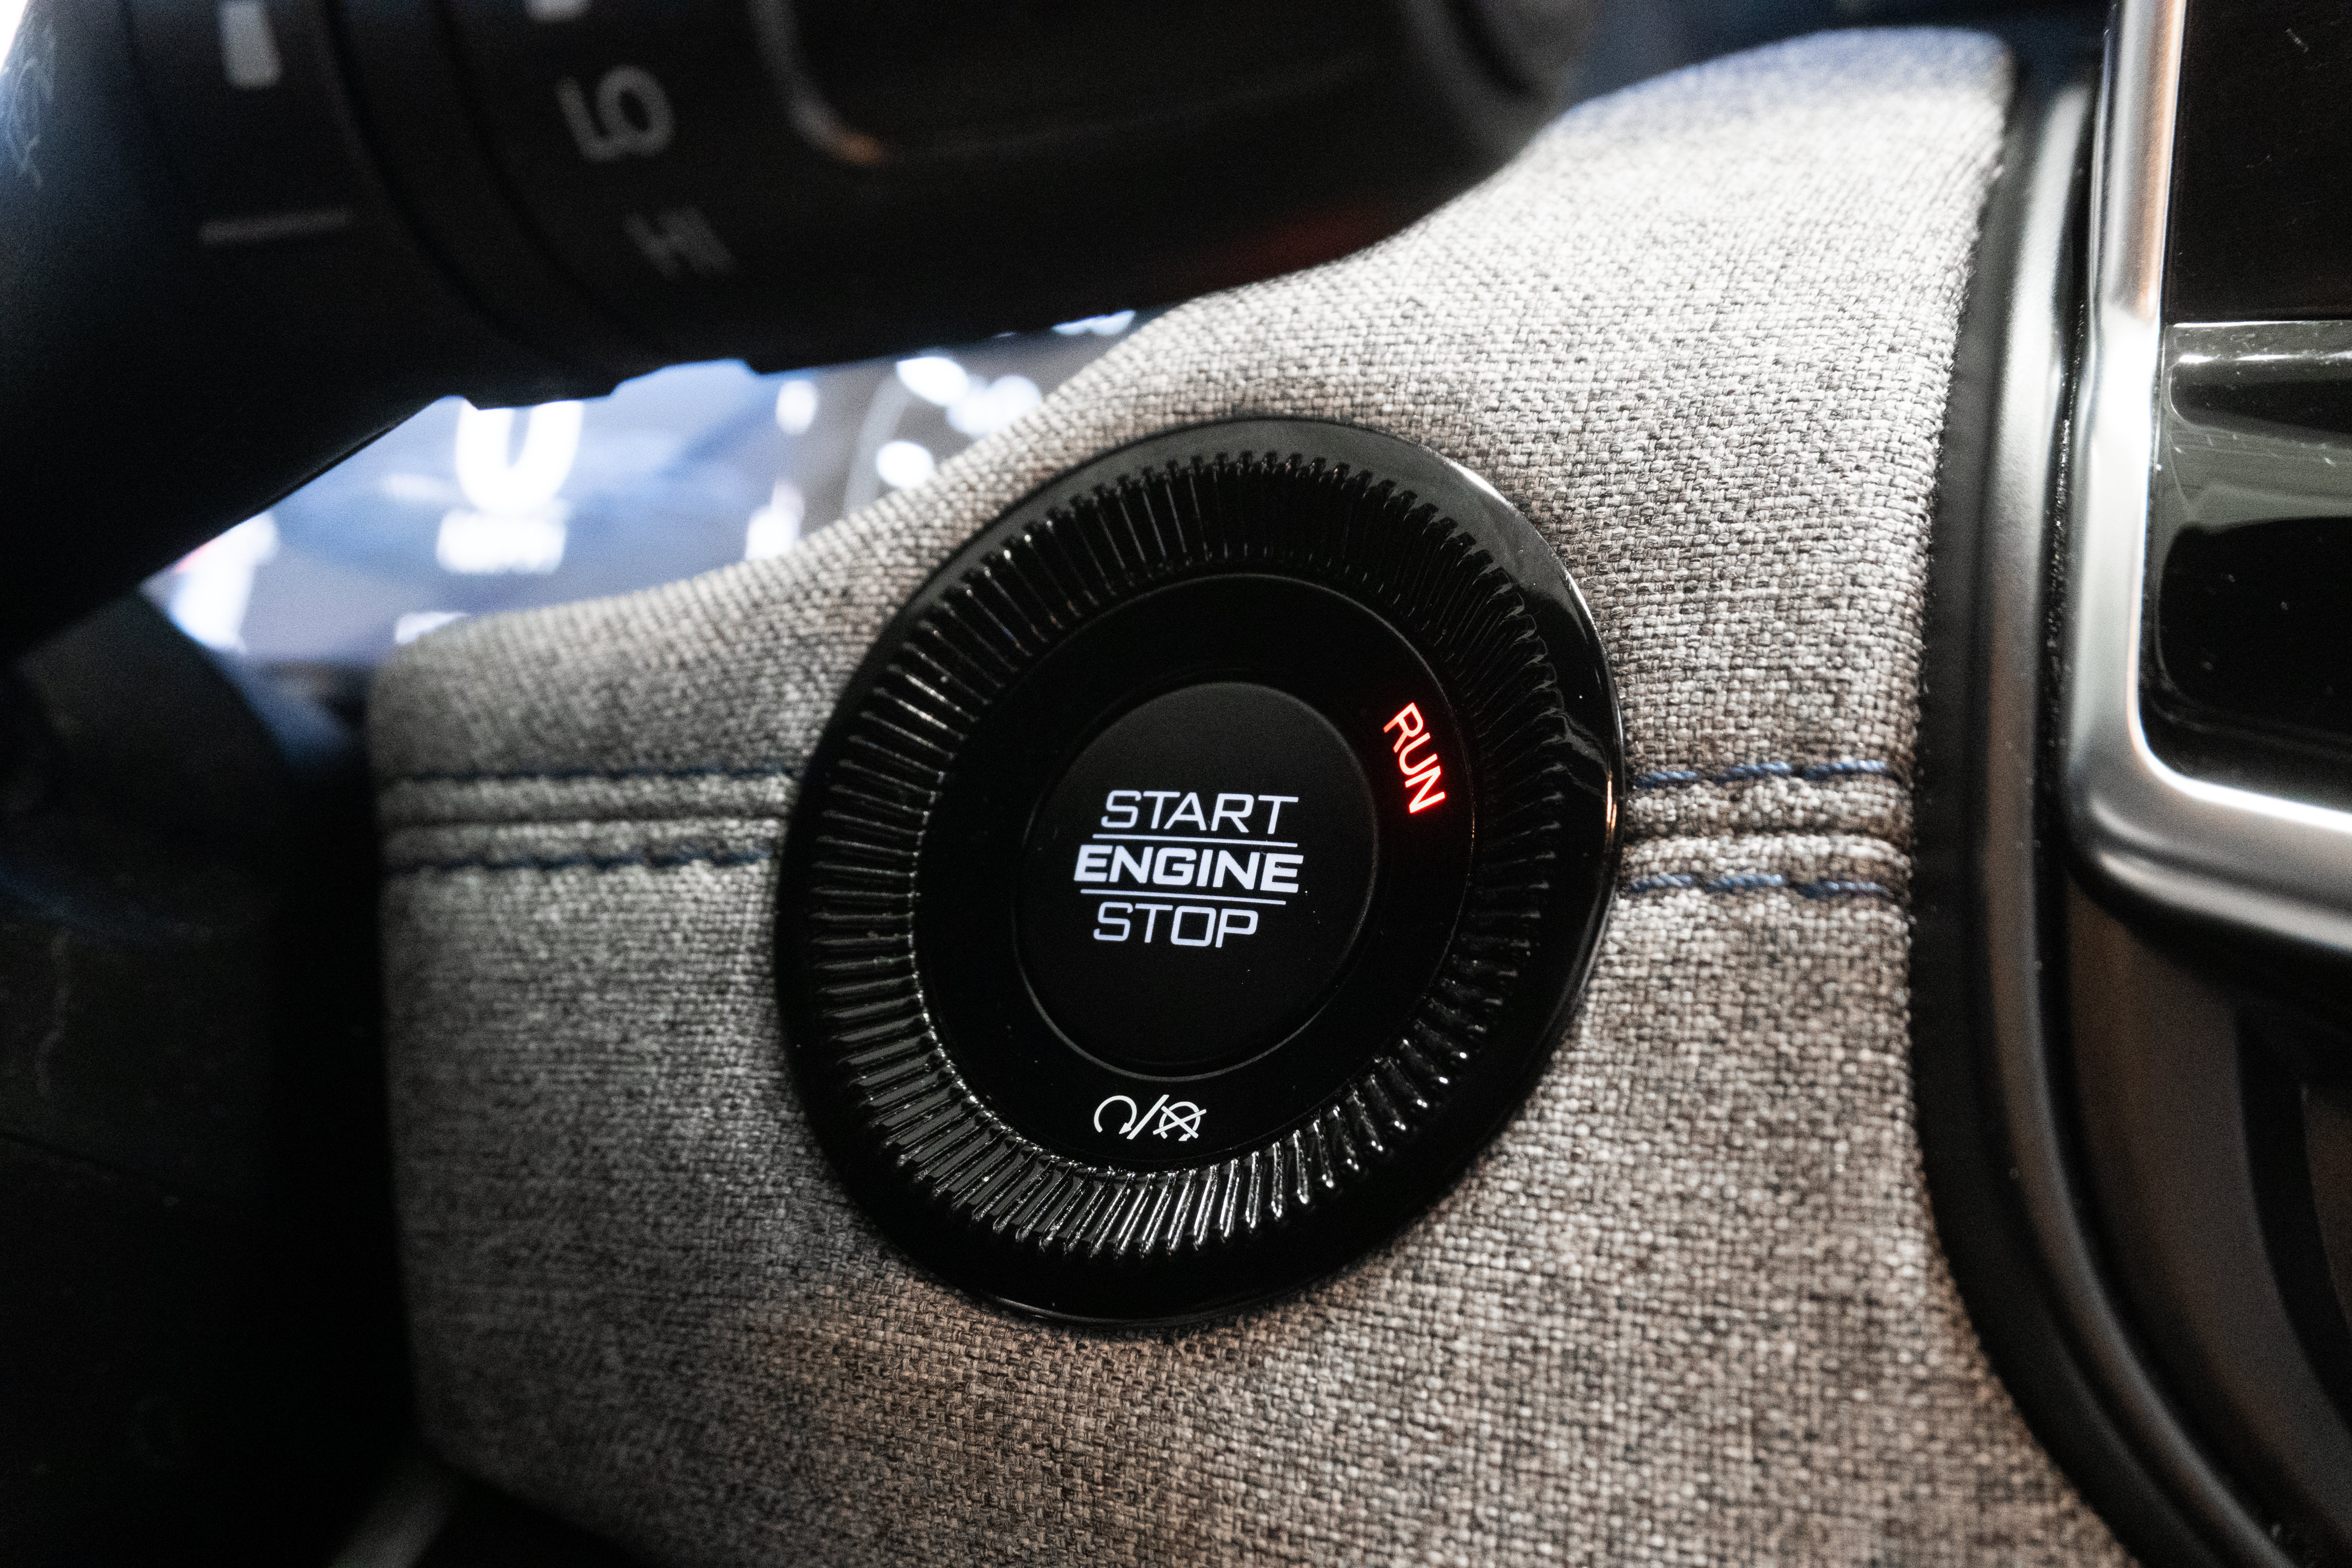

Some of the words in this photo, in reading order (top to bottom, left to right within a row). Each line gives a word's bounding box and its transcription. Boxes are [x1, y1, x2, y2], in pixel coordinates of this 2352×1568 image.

[1383, 702, 1447, 814] RUN
[1100, 789, 1299, 835] START
[1073, 844, 1304, 893] ENGINE
[1093, 901, 1259, 948] STOP
